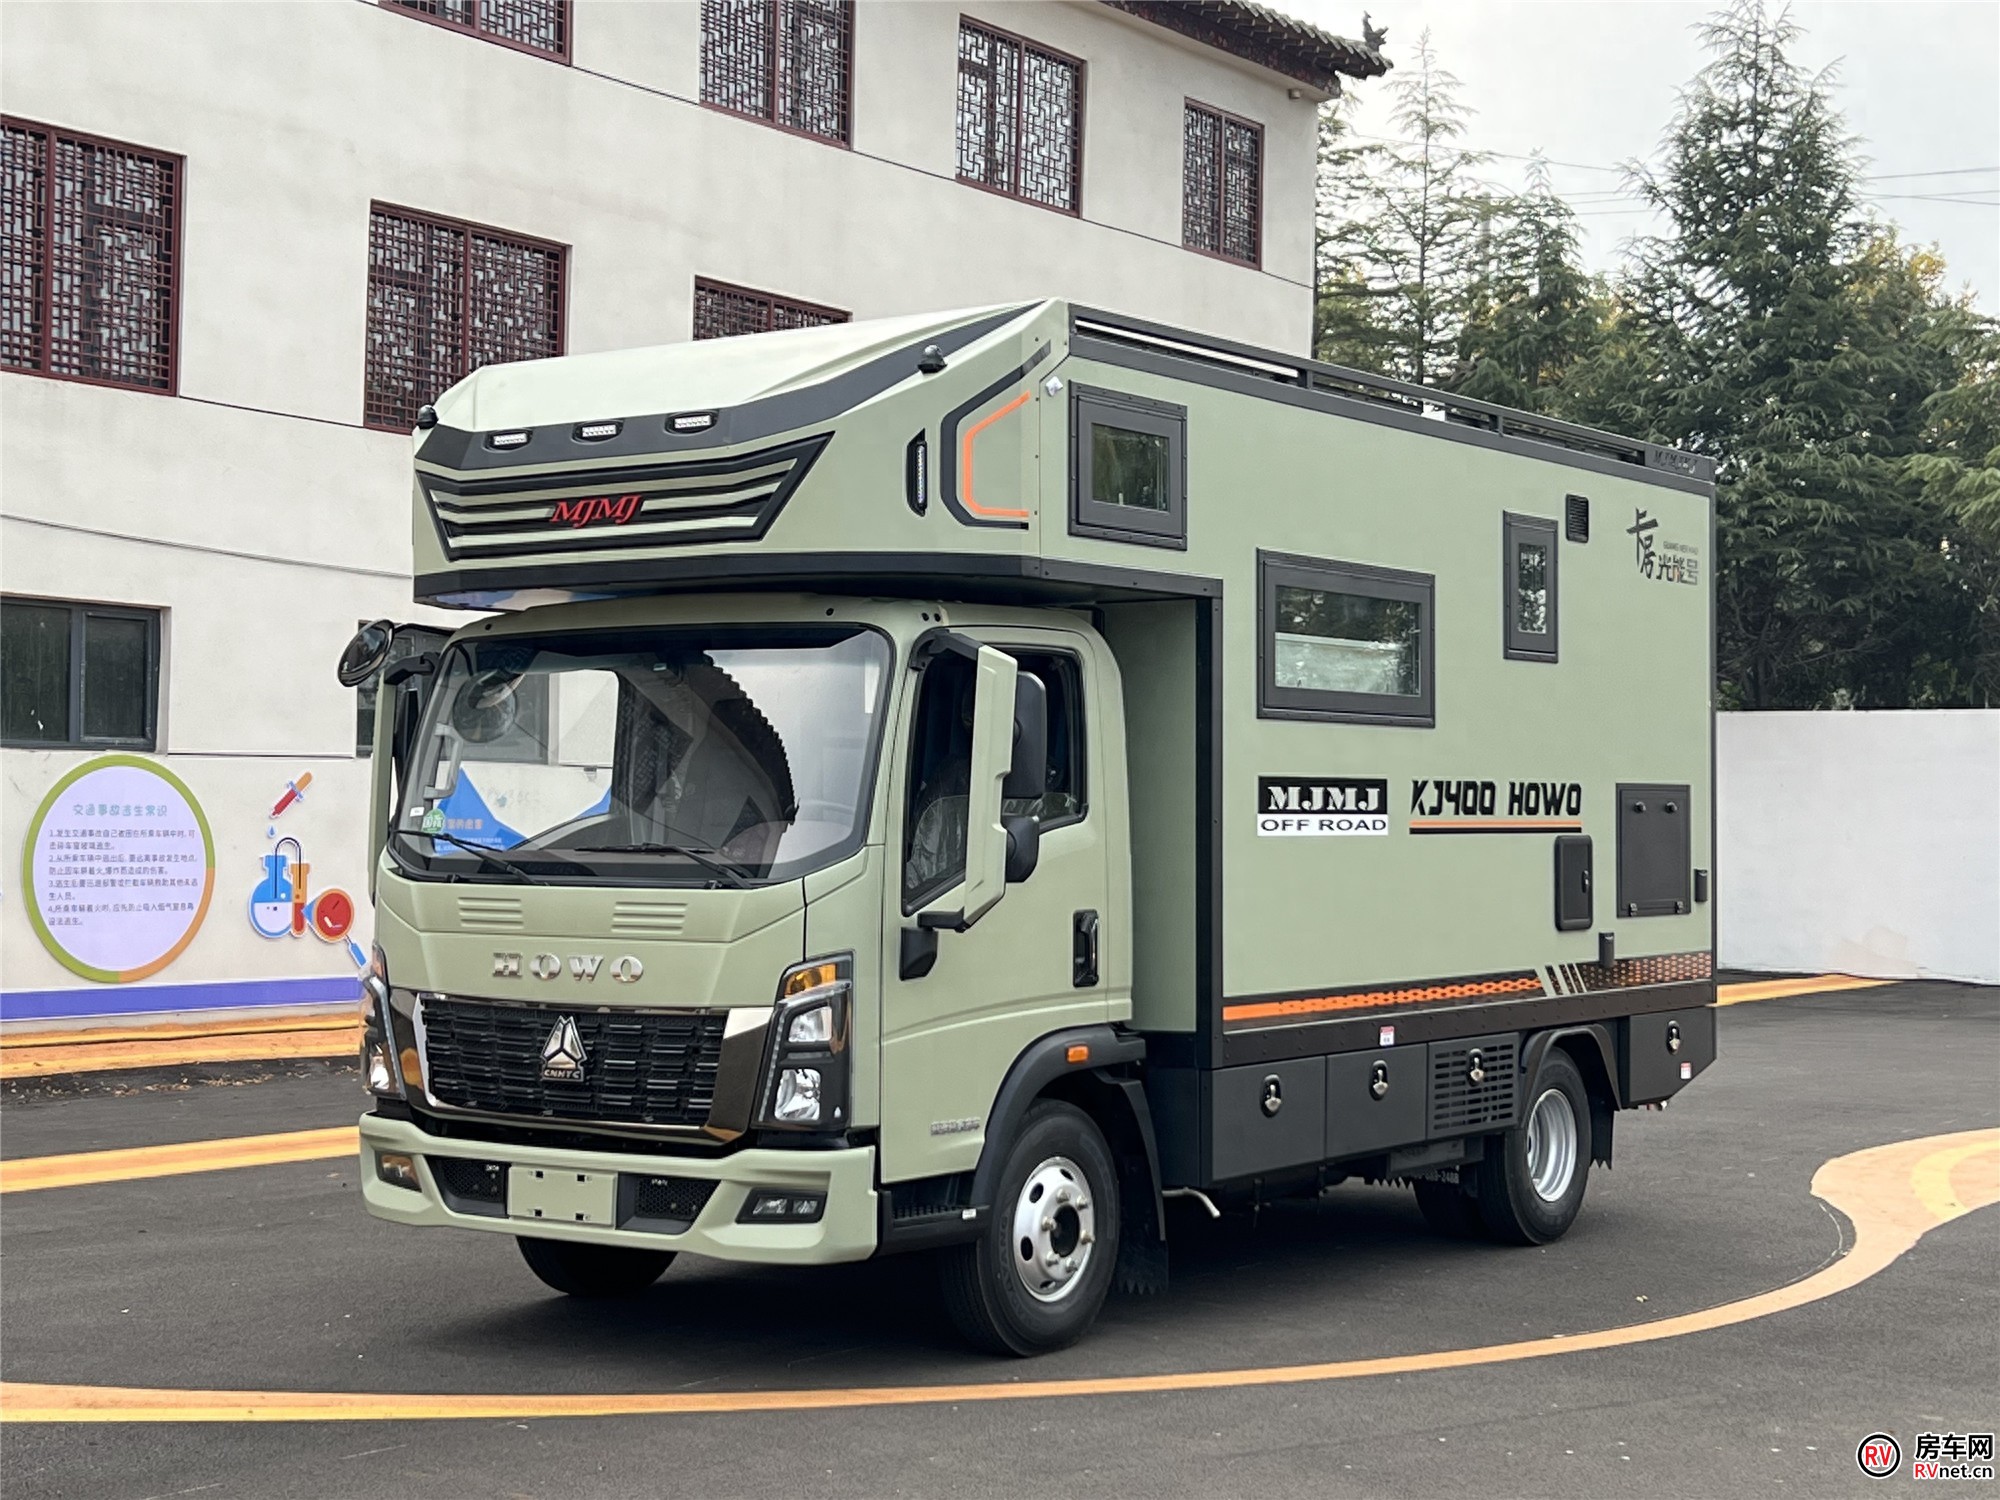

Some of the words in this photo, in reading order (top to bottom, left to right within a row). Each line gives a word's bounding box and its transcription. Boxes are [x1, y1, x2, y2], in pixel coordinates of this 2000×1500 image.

[549, 495, 642, 529] MJMJ
[1268, 786, 1380, 811] MJMJ
[1411, 780, 1496, 816] KJ400
[1508, 781, 1582, 816] HOWO
[1261, 819, 1309, 831] OFF
[1319, 819, 1387, 831] ROAD
[493, 952, 644, 983] HOWO
